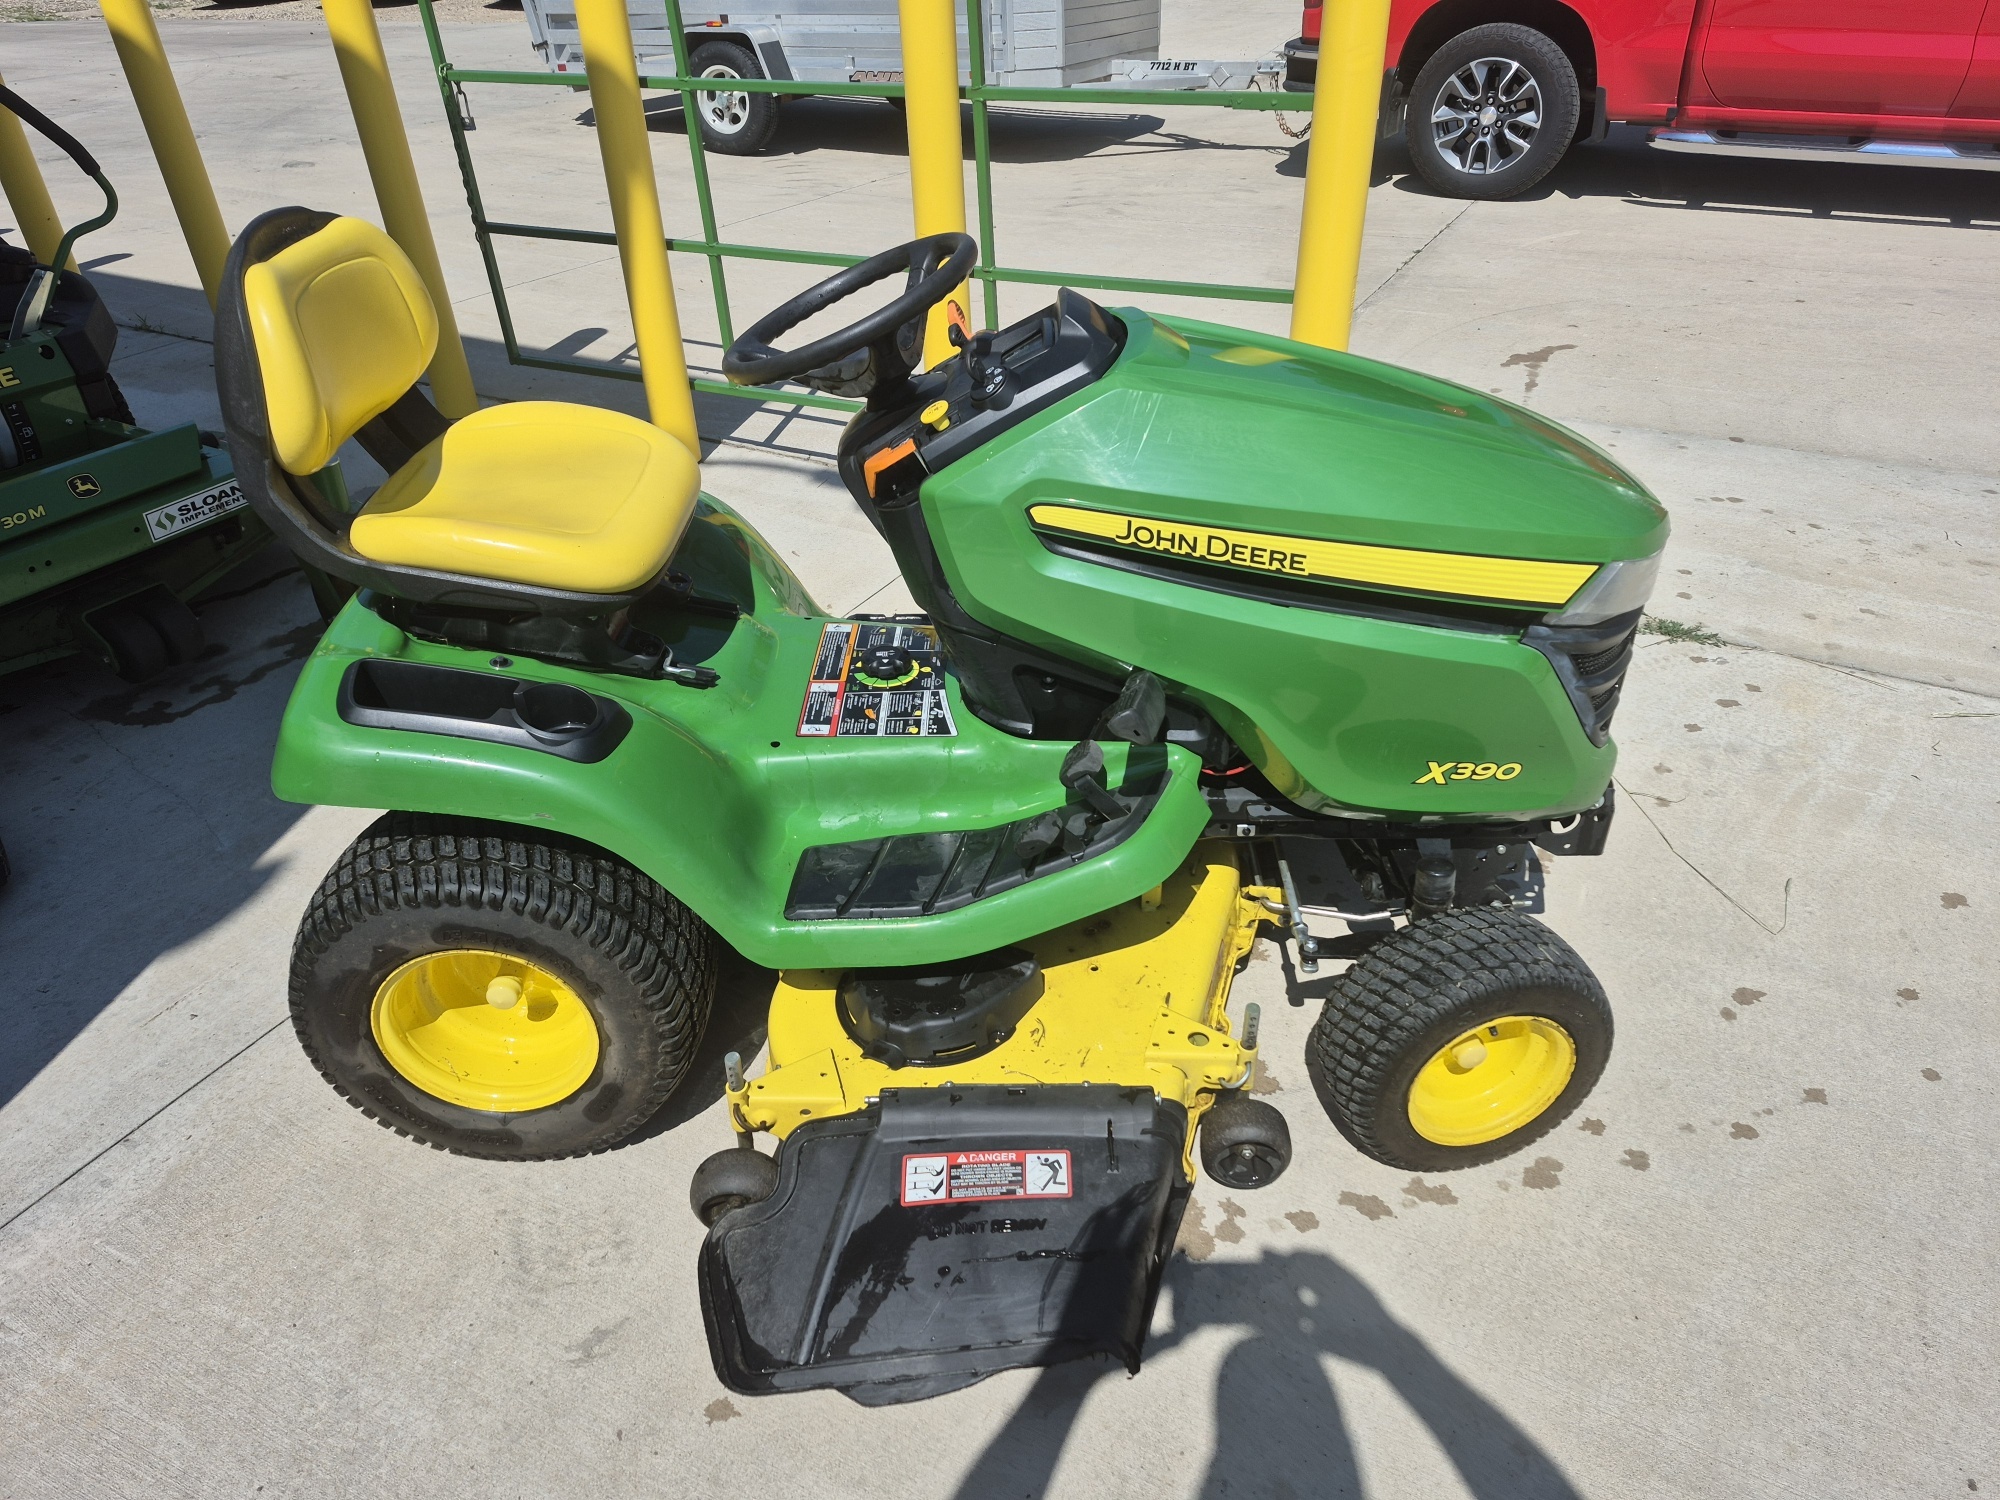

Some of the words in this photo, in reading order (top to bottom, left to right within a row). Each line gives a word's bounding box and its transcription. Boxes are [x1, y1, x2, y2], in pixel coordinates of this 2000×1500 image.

[1150, 62, 1171, 71] 7712
[1183, 62, 1198, 71] BT
[1115, 519, 1198, 554] JOHN
[1206, 534, 1307, 573] DEERE
[1411, 760, 1522, 785] X390
[969, 1152, 1017, 1162] DANGER
